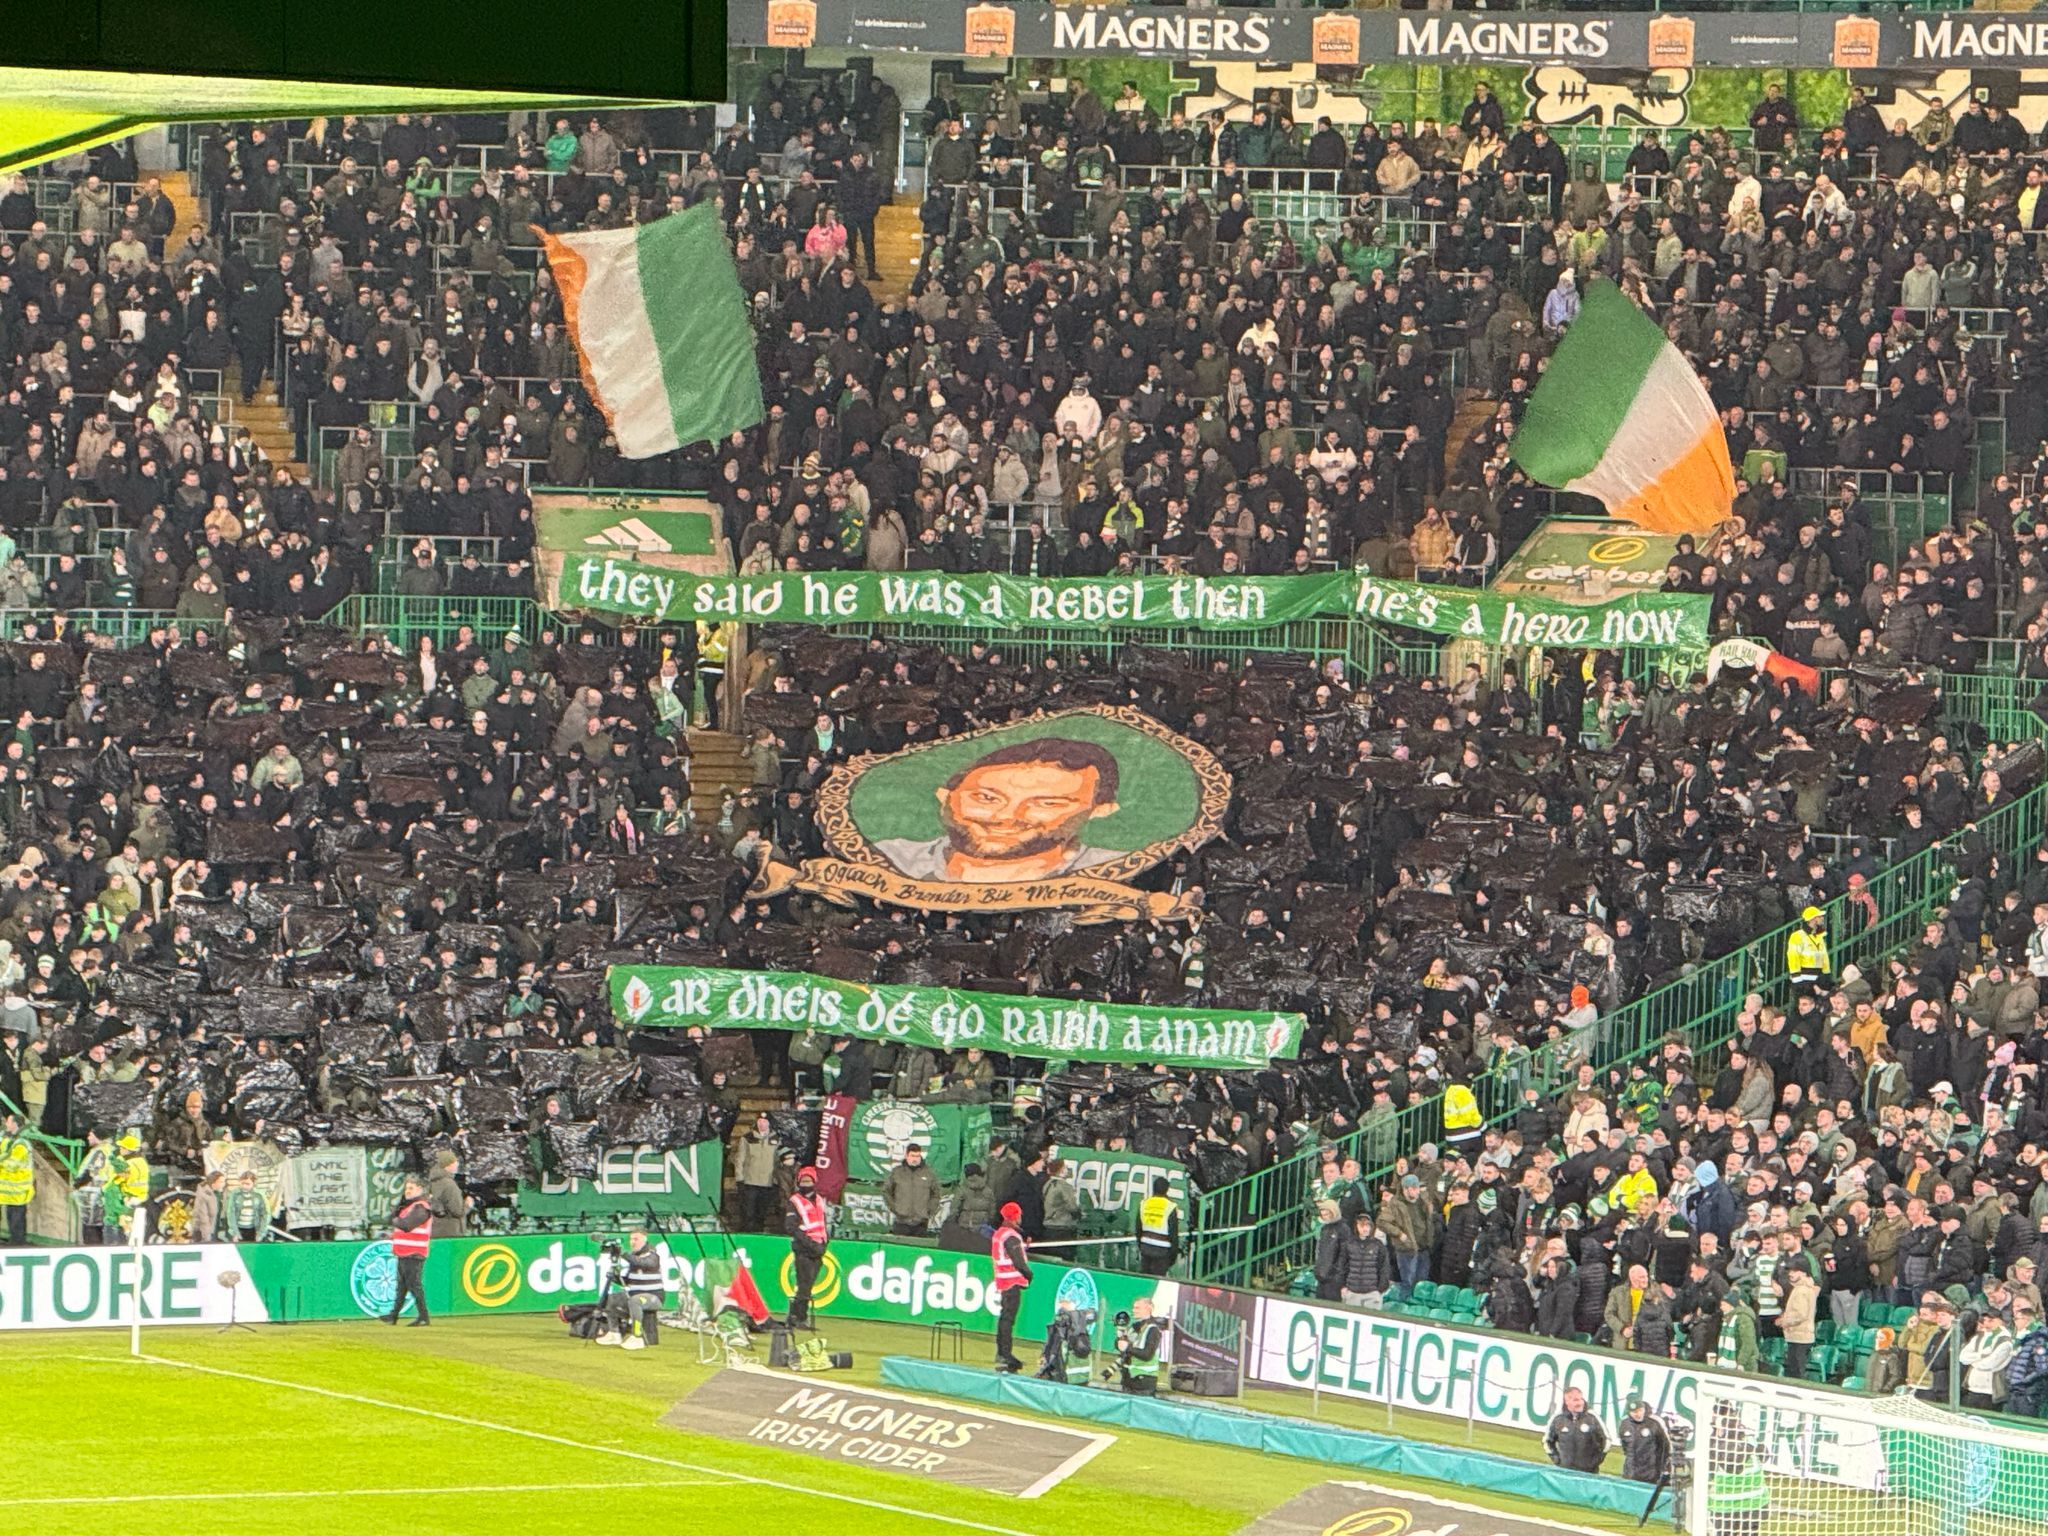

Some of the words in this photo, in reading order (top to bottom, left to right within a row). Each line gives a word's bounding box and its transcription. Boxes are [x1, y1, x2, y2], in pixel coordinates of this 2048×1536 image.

[1053, 11, 1271, 54] MAGNERS
[1397, 18, 1610, 58] MAGNERS
[802, 574, 858, 617] he
[980, 585, 1003, 617] a
[1168, 576, 1266, 620] then
[1461, 604, 1484, 636] a
[861, 1100, 893, 1127] GREEN
[310, 1161, 348, 1171] UNTIL
[317, 1173, 342, 1181] THE
[313, 1183, 349, 1193] LAST
[0, 1252, 202, 1323] TORE
[775, 1388, 985, 1449] MAGNERS
[747, 1418, 841, 1452] IRISH
[841, 1437, 946, 1474] CIDER
